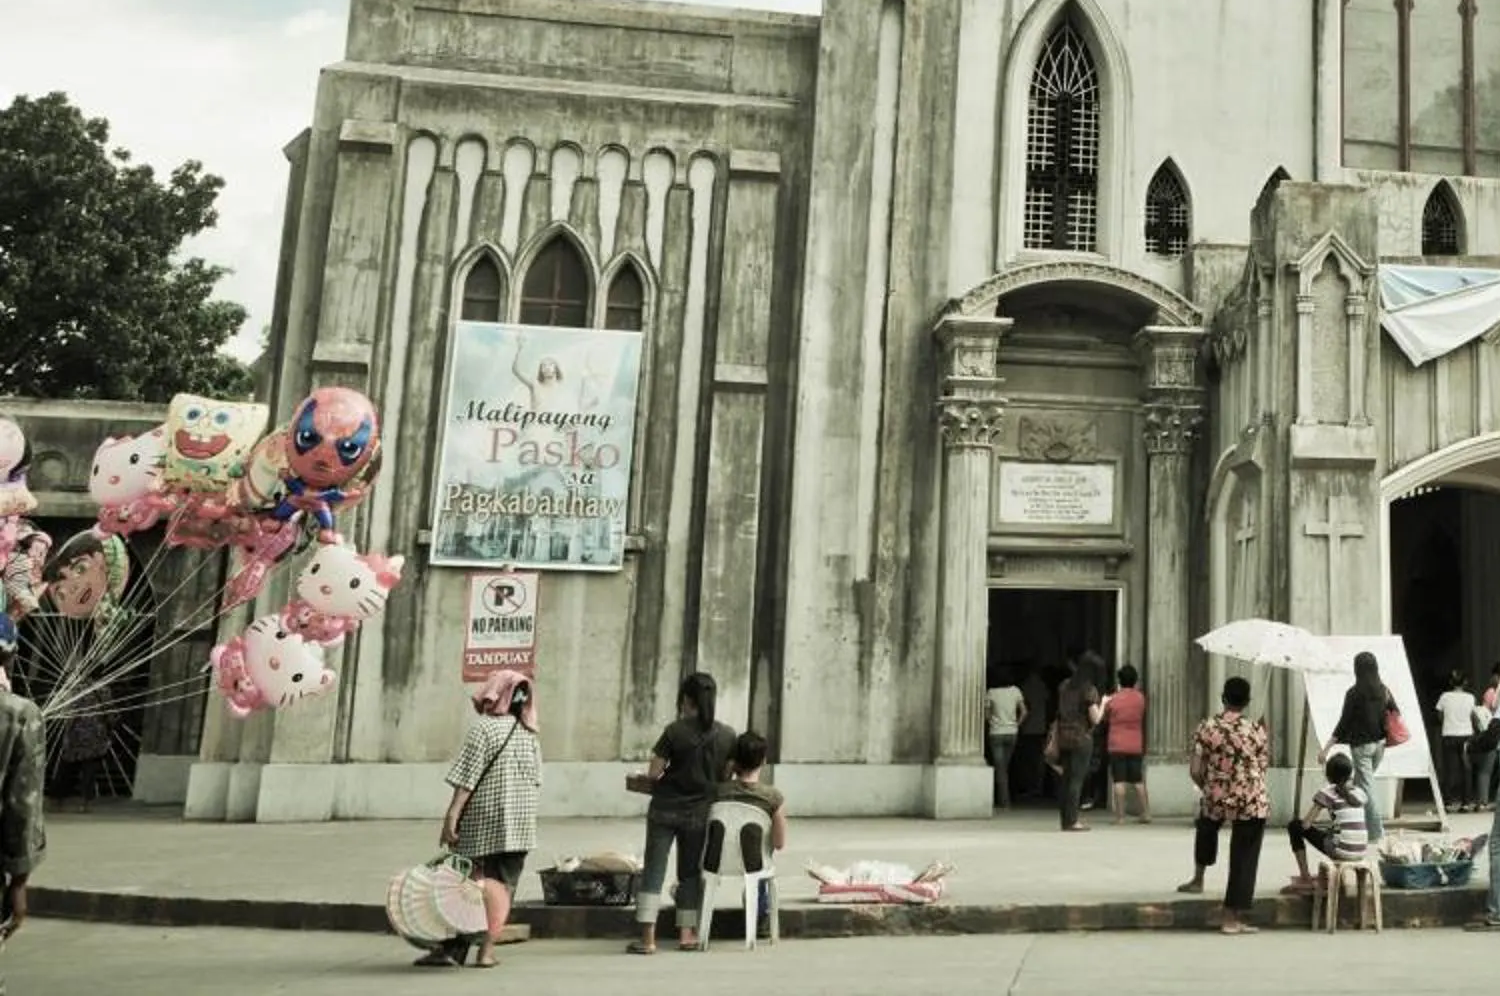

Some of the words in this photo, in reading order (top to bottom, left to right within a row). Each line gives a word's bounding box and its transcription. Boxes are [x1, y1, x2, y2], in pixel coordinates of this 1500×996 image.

[456, 400, 612, 432] Malipayong
[485, 427, 621, 470] Pasko
[567, 471, 595, 487] sa
[441, 483, 622, 523] Pagkabanhaw
[472, 617, 487, 633] NO
[488, 615, 533, 633] PARKING
[466, 651, 531, 666] TANDUAY
